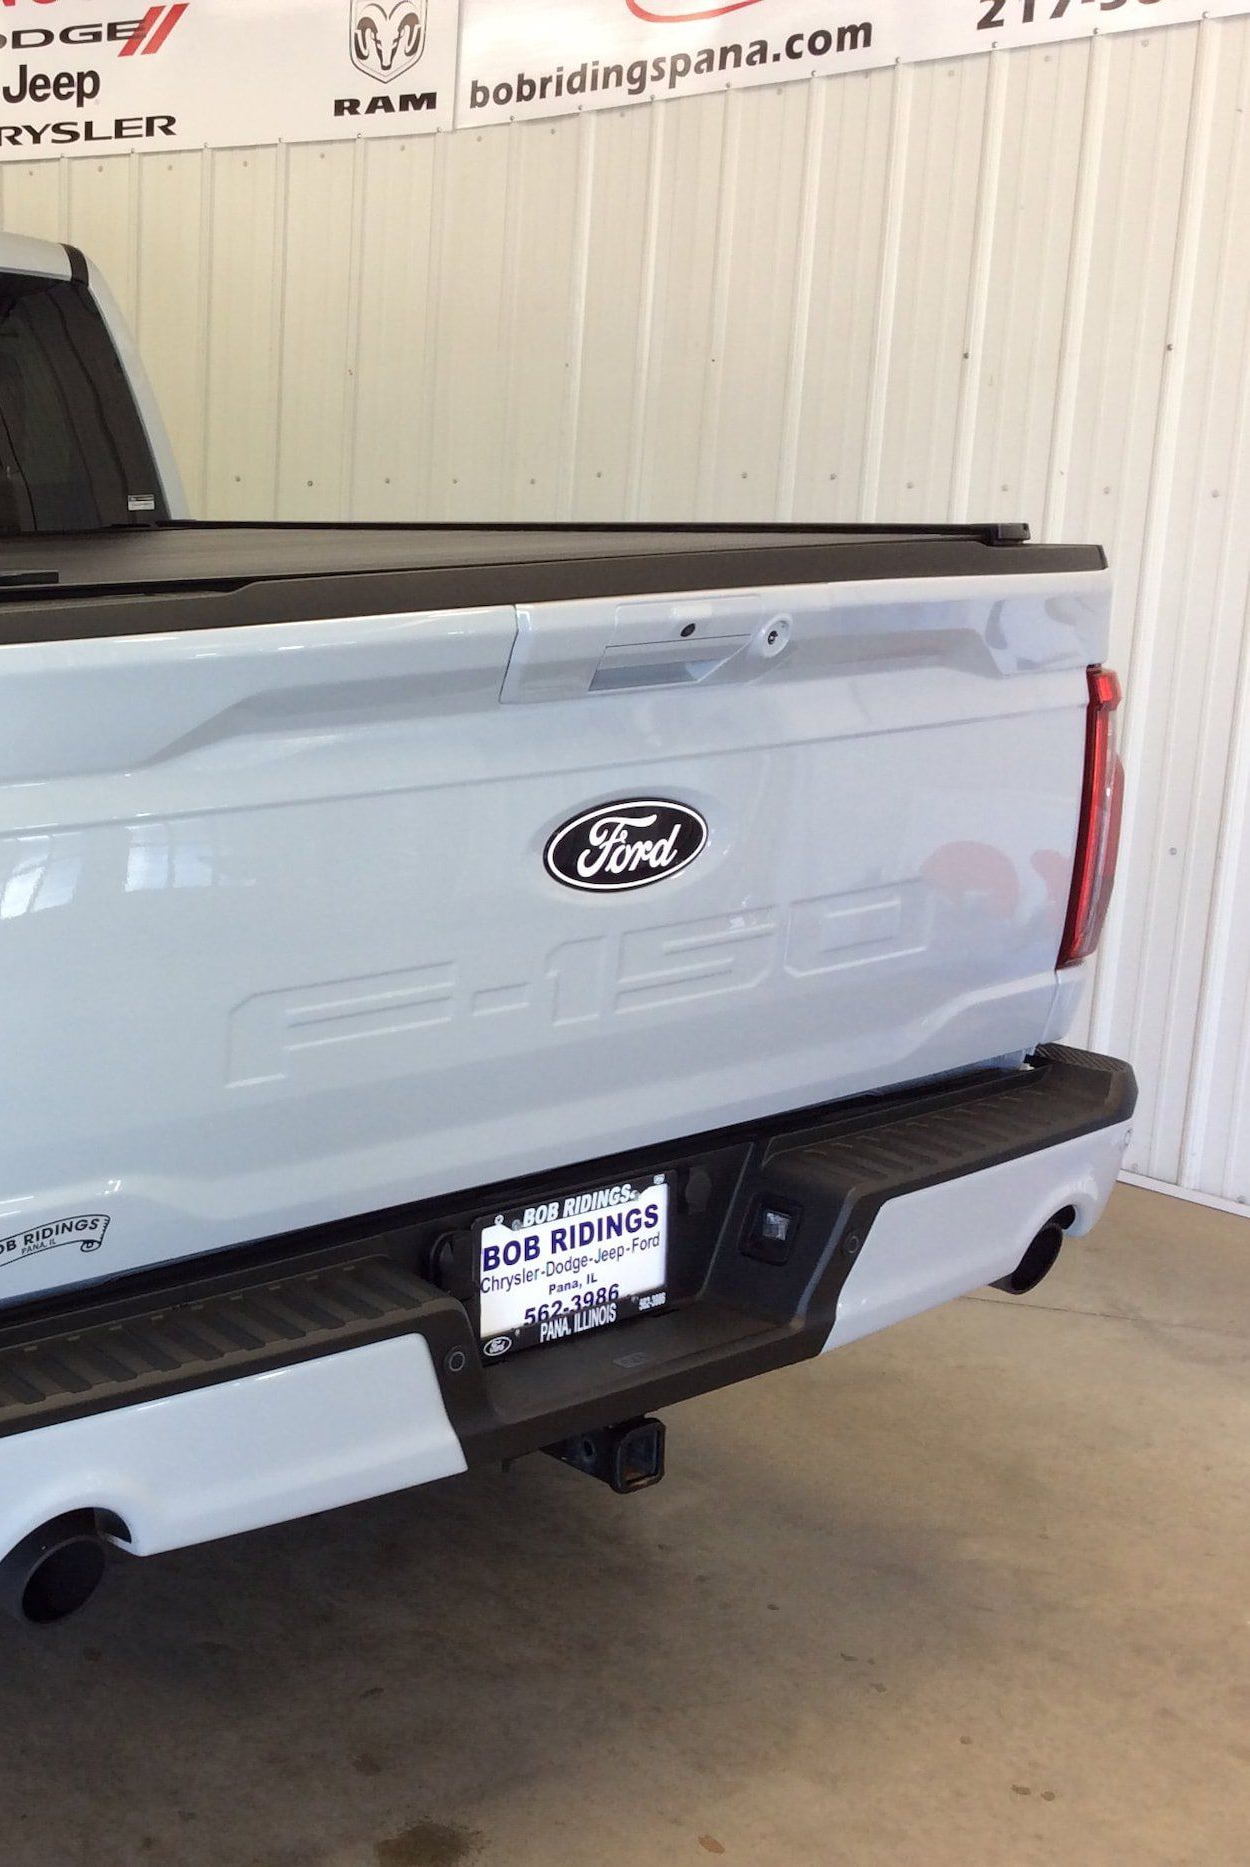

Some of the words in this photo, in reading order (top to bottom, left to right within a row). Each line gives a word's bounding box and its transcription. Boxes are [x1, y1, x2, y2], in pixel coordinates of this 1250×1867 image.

[2, 64, 100, 107] Jeep
[469, 20, 873, 109] bobridingspana.com
[333, 91, 438, 117] RAM
[576, 814, 682, 878] Ford
[226, 876, 936, 1089] F-150
[522, 1202, 559, 1228] BOB
[562, 1183, 632, 1218] RIDINGS
[23, 1218, 100, 1246] RIDINGS
[482, 1235, 541, 1272] BOB
[551, 1203, 659, 1254] RIDINGS
[481, 1232, 661, 1294] Chrysler-Dodge-Jeep-Ford
[548, 1280, 583, 1295] Pana,
[586, 1272, 598, 1285] IL
[524, 1283, 619, 1326] 562-3986
[573, 1302, 617, 1333] ILLINOIS
